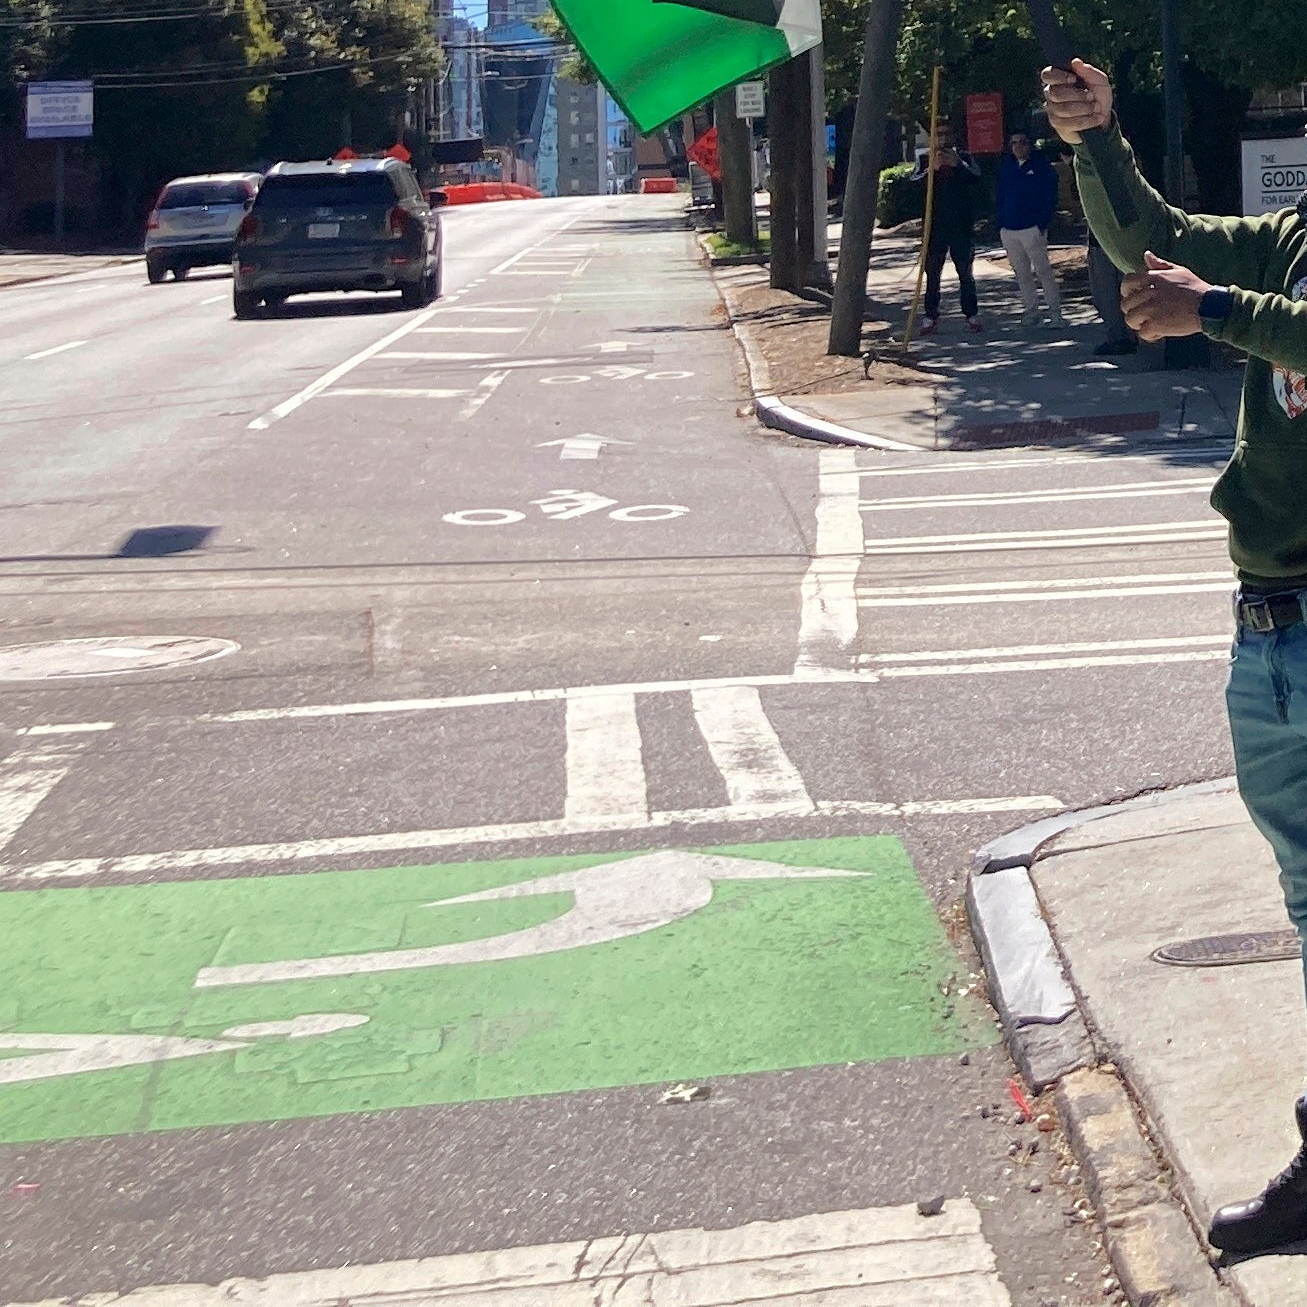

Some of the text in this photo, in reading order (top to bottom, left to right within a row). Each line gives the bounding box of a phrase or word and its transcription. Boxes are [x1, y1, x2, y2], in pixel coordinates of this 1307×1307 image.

[1261, 154, 1276, 164] THE
[1261, 194, 1299, 205] FOR EARL
